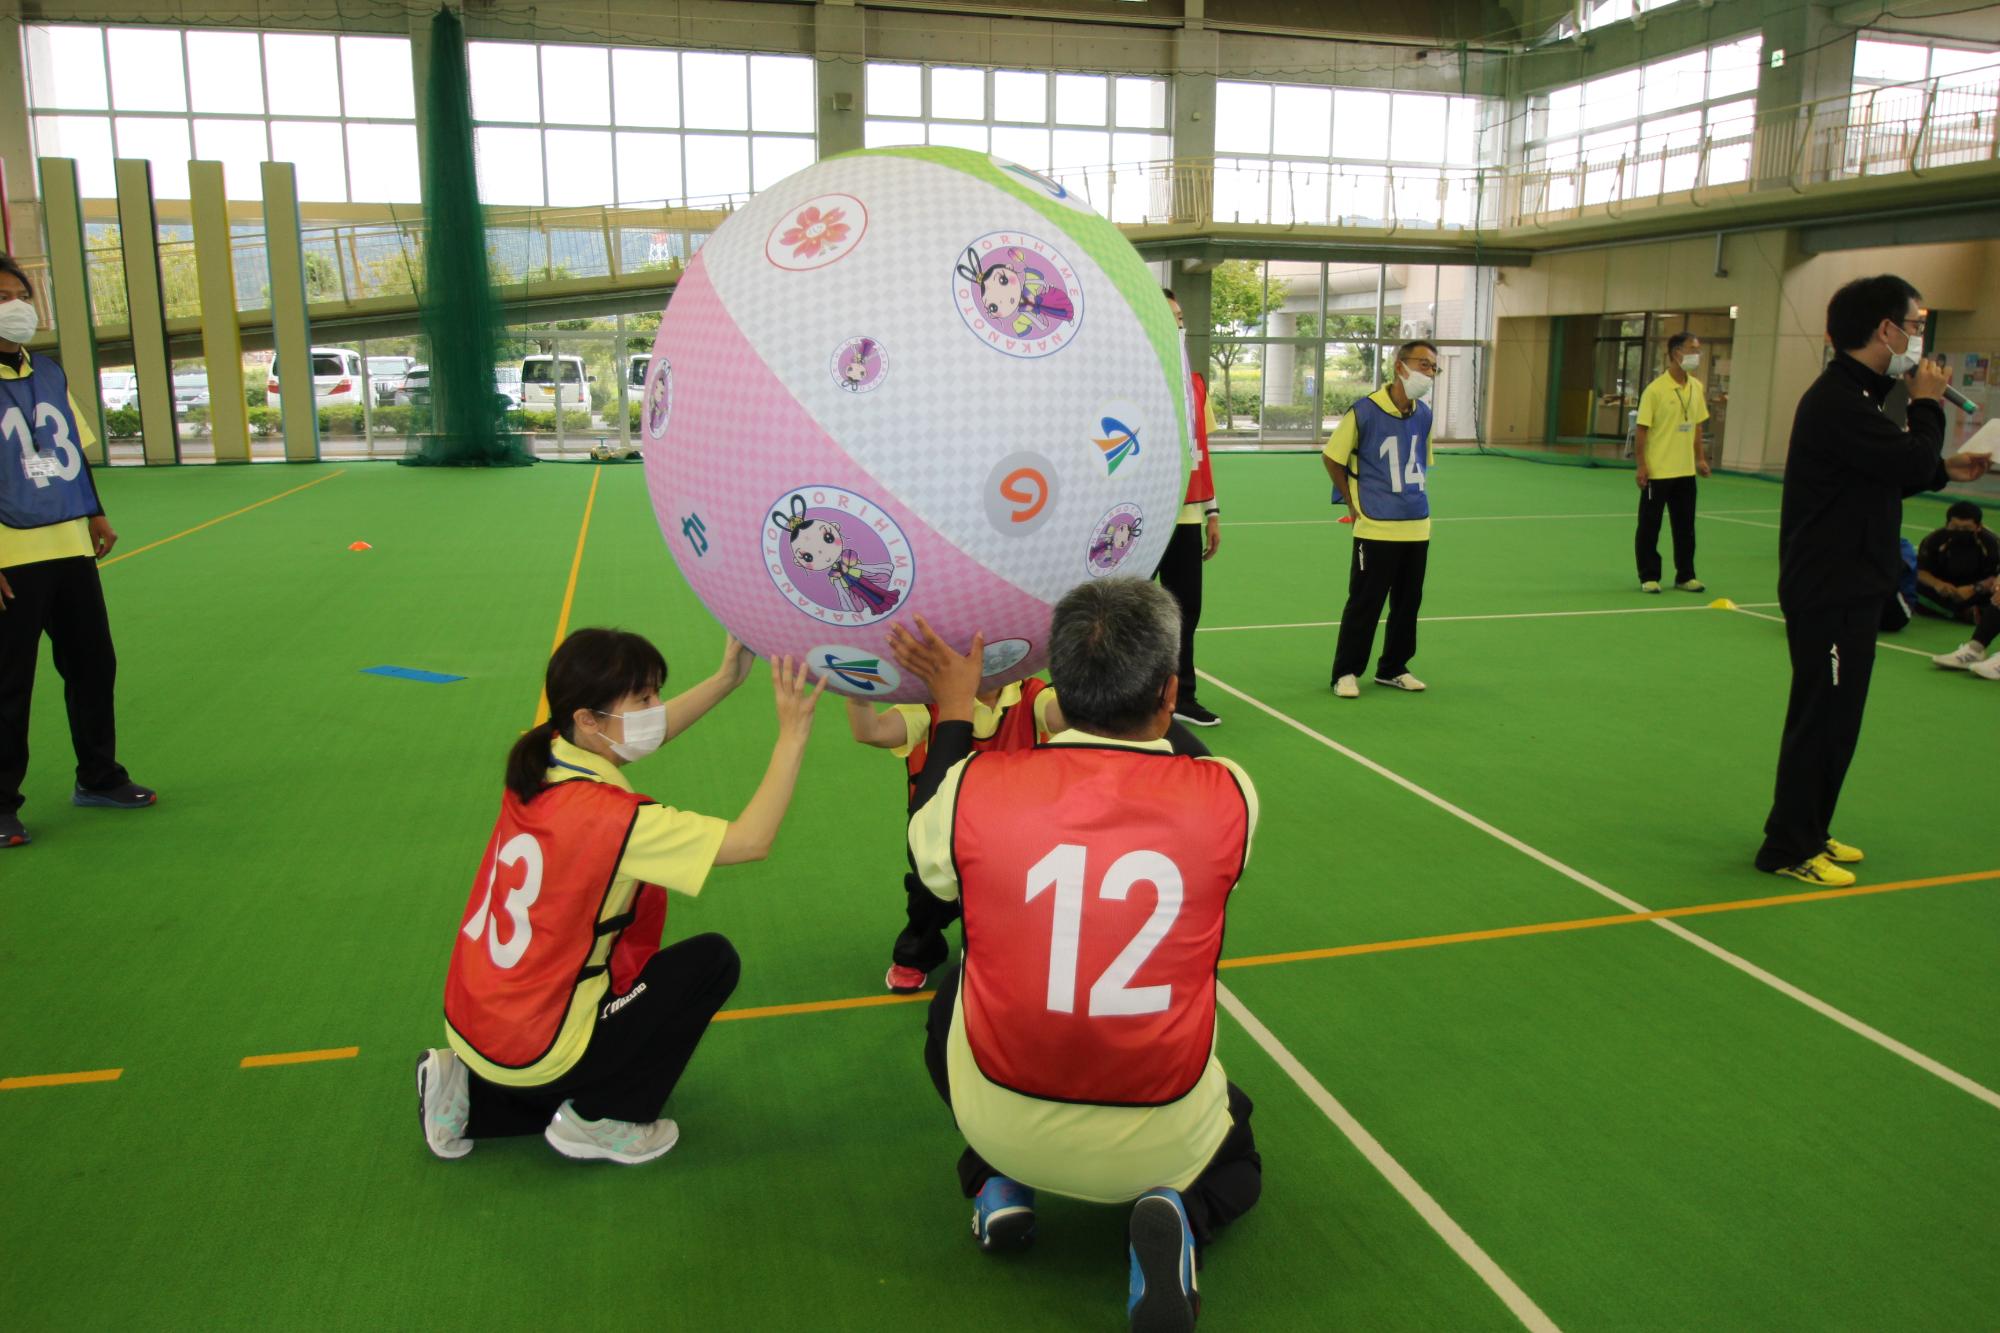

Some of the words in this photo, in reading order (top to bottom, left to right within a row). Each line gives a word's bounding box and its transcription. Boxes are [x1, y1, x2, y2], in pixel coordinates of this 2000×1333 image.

[981, 235, 1079, 296] ORIHIME
[959, 288, 1063, 353] NAKANOTO
[1, 402, 81, 488] 13
[1379, 434, 1426, 493] 14
[767, 527, 864, 622] NAKANOTO
[813, 491, 909, 587] ORIHIME
[1025, 843, 1183, 1017] 12
